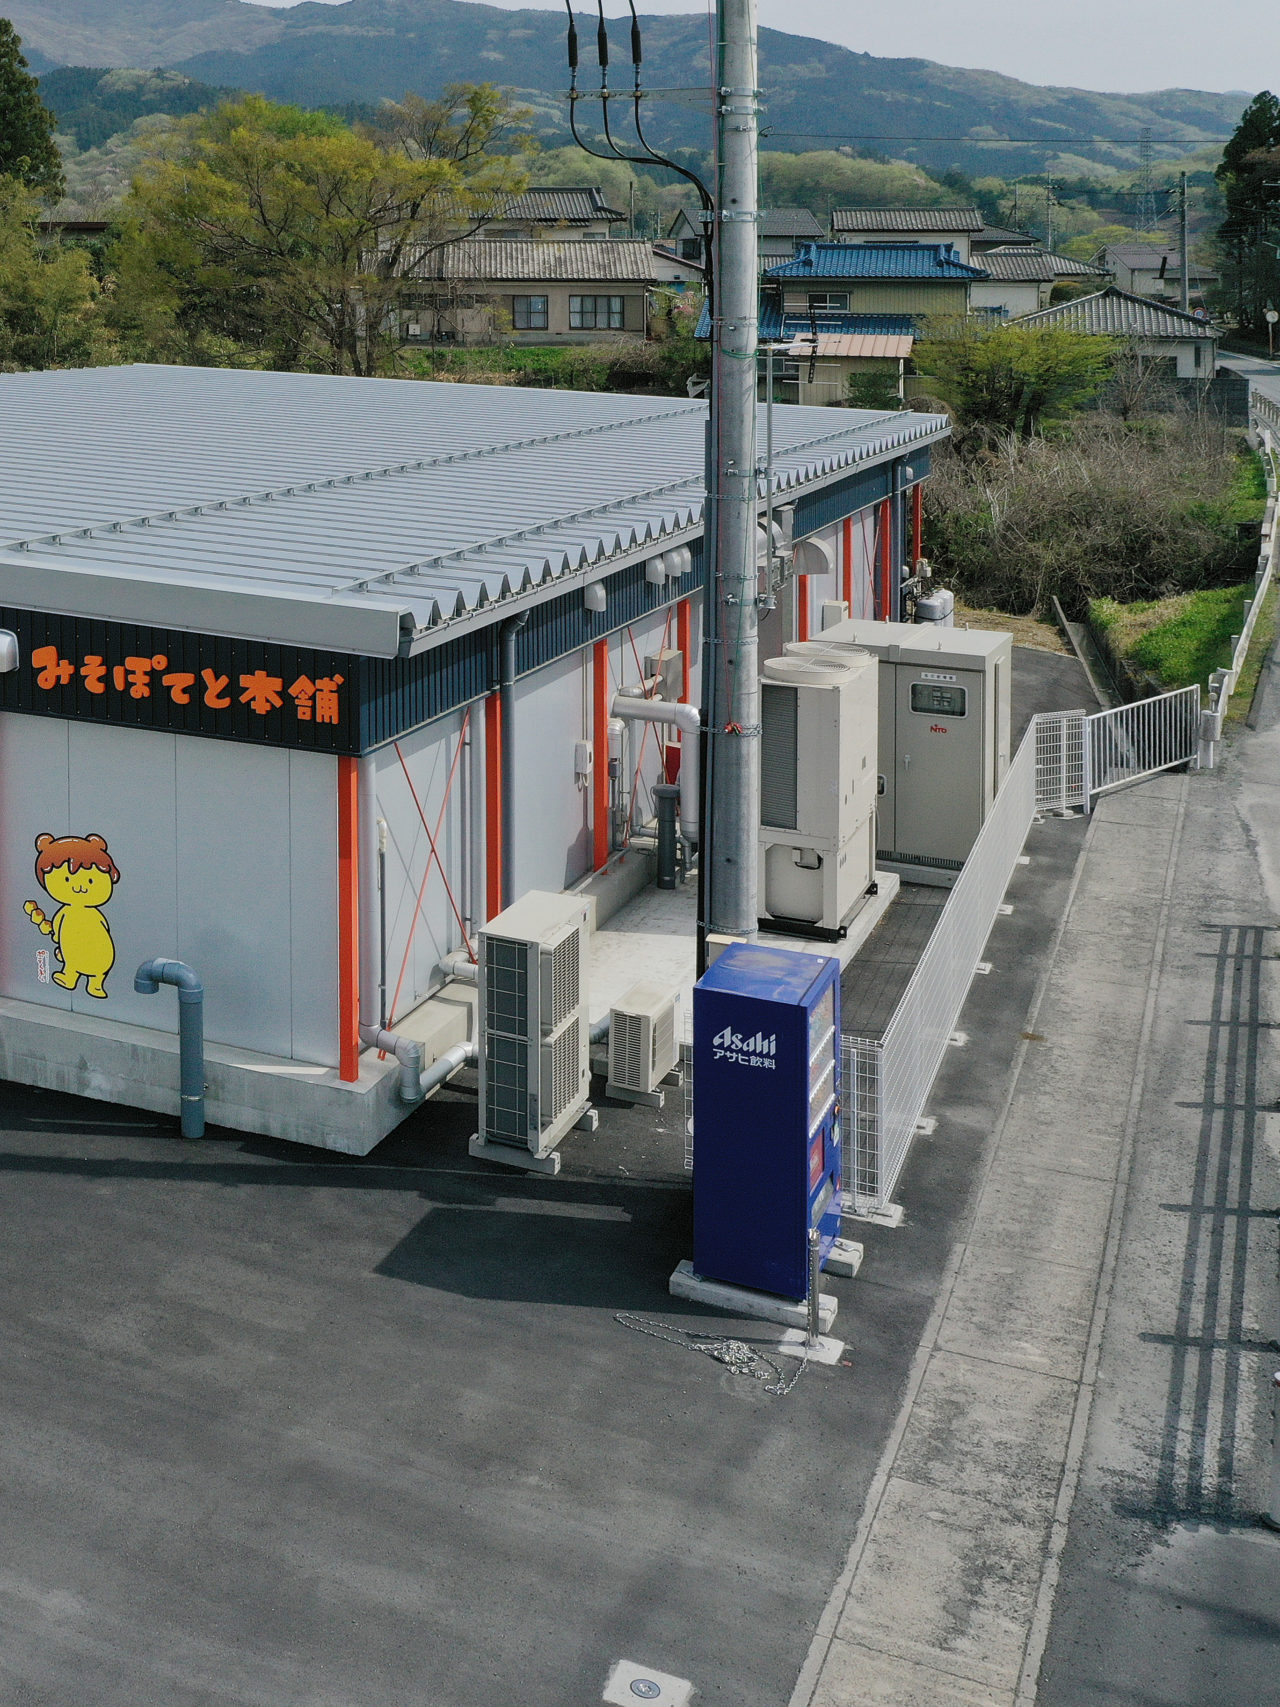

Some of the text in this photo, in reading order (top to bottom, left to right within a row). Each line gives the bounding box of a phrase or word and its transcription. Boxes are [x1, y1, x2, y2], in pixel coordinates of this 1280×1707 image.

[31, 645, 345, 725] みそぽてと本舗
[712, 1026, 776, 1056] Asahi
[712, 1048, 776, 1070] アサヒ飲料
